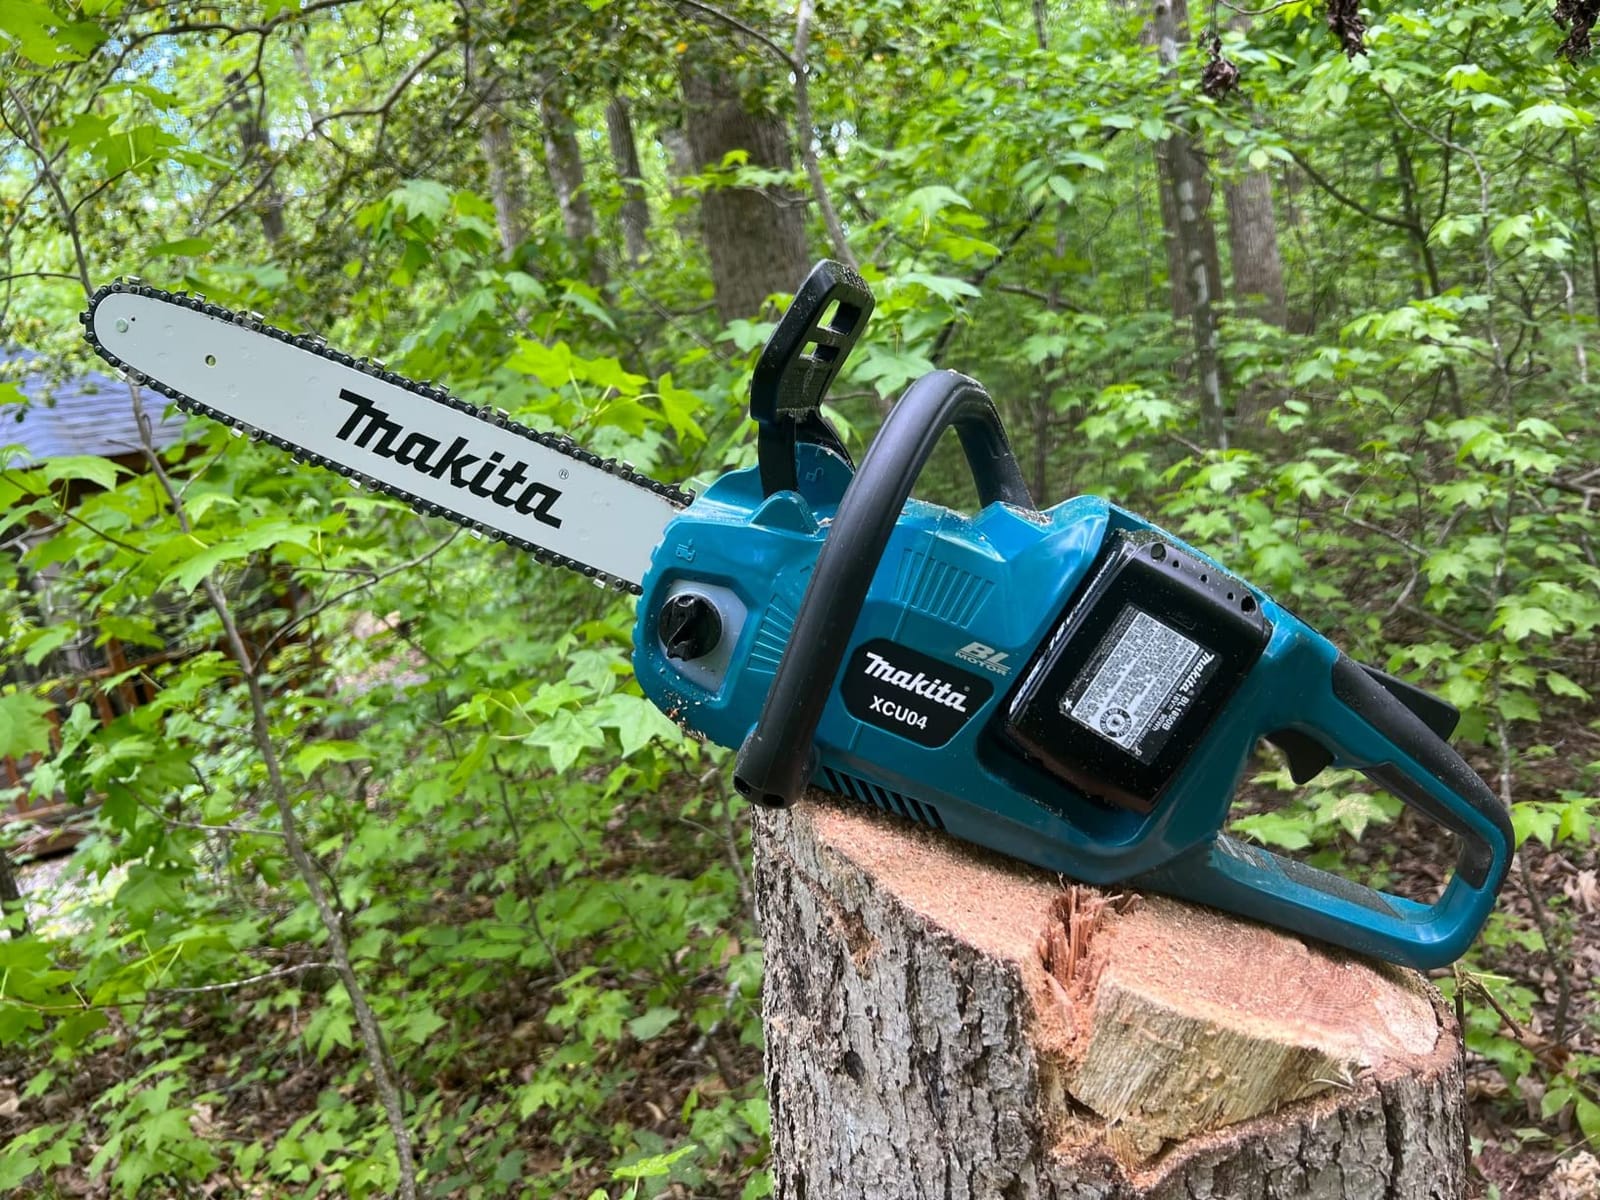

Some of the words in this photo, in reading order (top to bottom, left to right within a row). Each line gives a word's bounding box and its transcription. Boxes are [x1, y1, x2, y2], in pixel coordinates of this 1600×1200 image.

[955, 652, 1007, 676] MOTOR
[958, 641, 1012, 671] BL
[869, 695, 928, 730] XCU04
[1162, 695, 1189, 731] BL1850B
